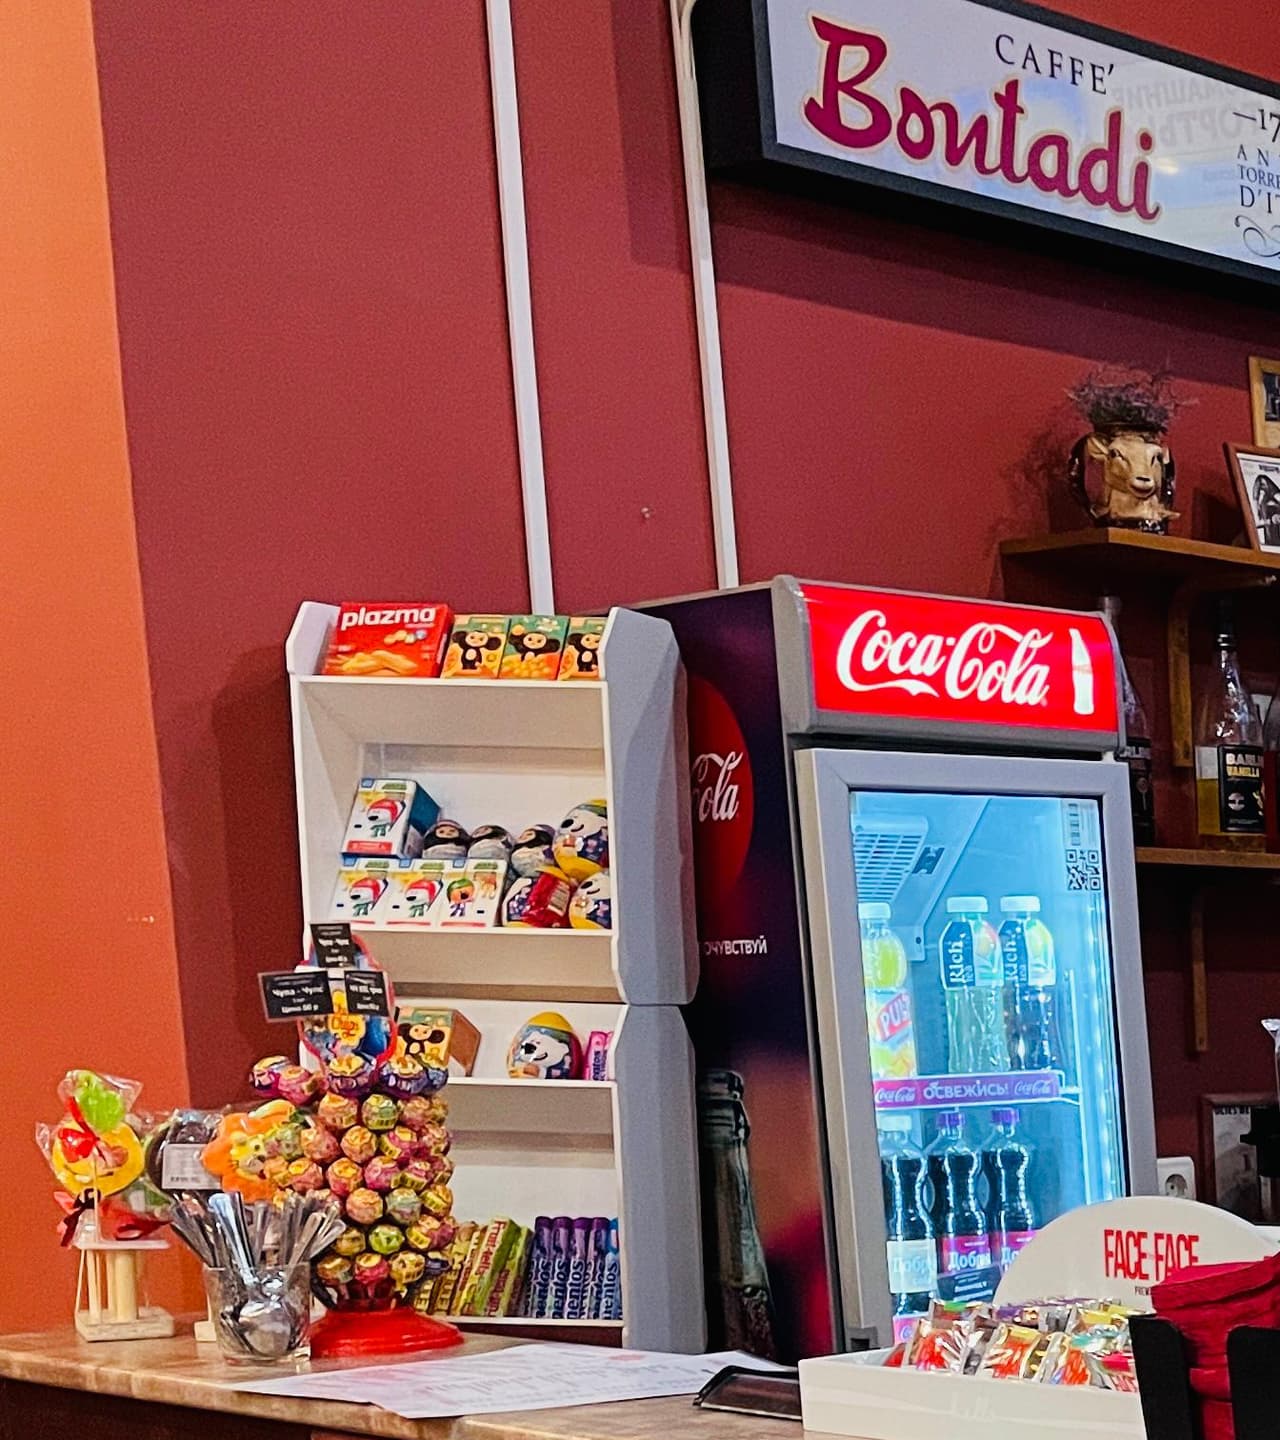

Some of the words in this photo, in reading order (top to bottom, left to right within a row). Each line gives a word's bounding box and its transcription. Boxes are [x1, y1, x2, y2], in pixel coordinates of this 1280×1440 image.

[804, 15, 1160, 221] Bontadi
[341, 606, 436, 631] plazma
[836, 609, 1054, 707] Coca-Cola
[923, 1081, 1008, 1100] ОСВЕЖИСЬ!
[1104, 1229, 1149, 1280] FACE
